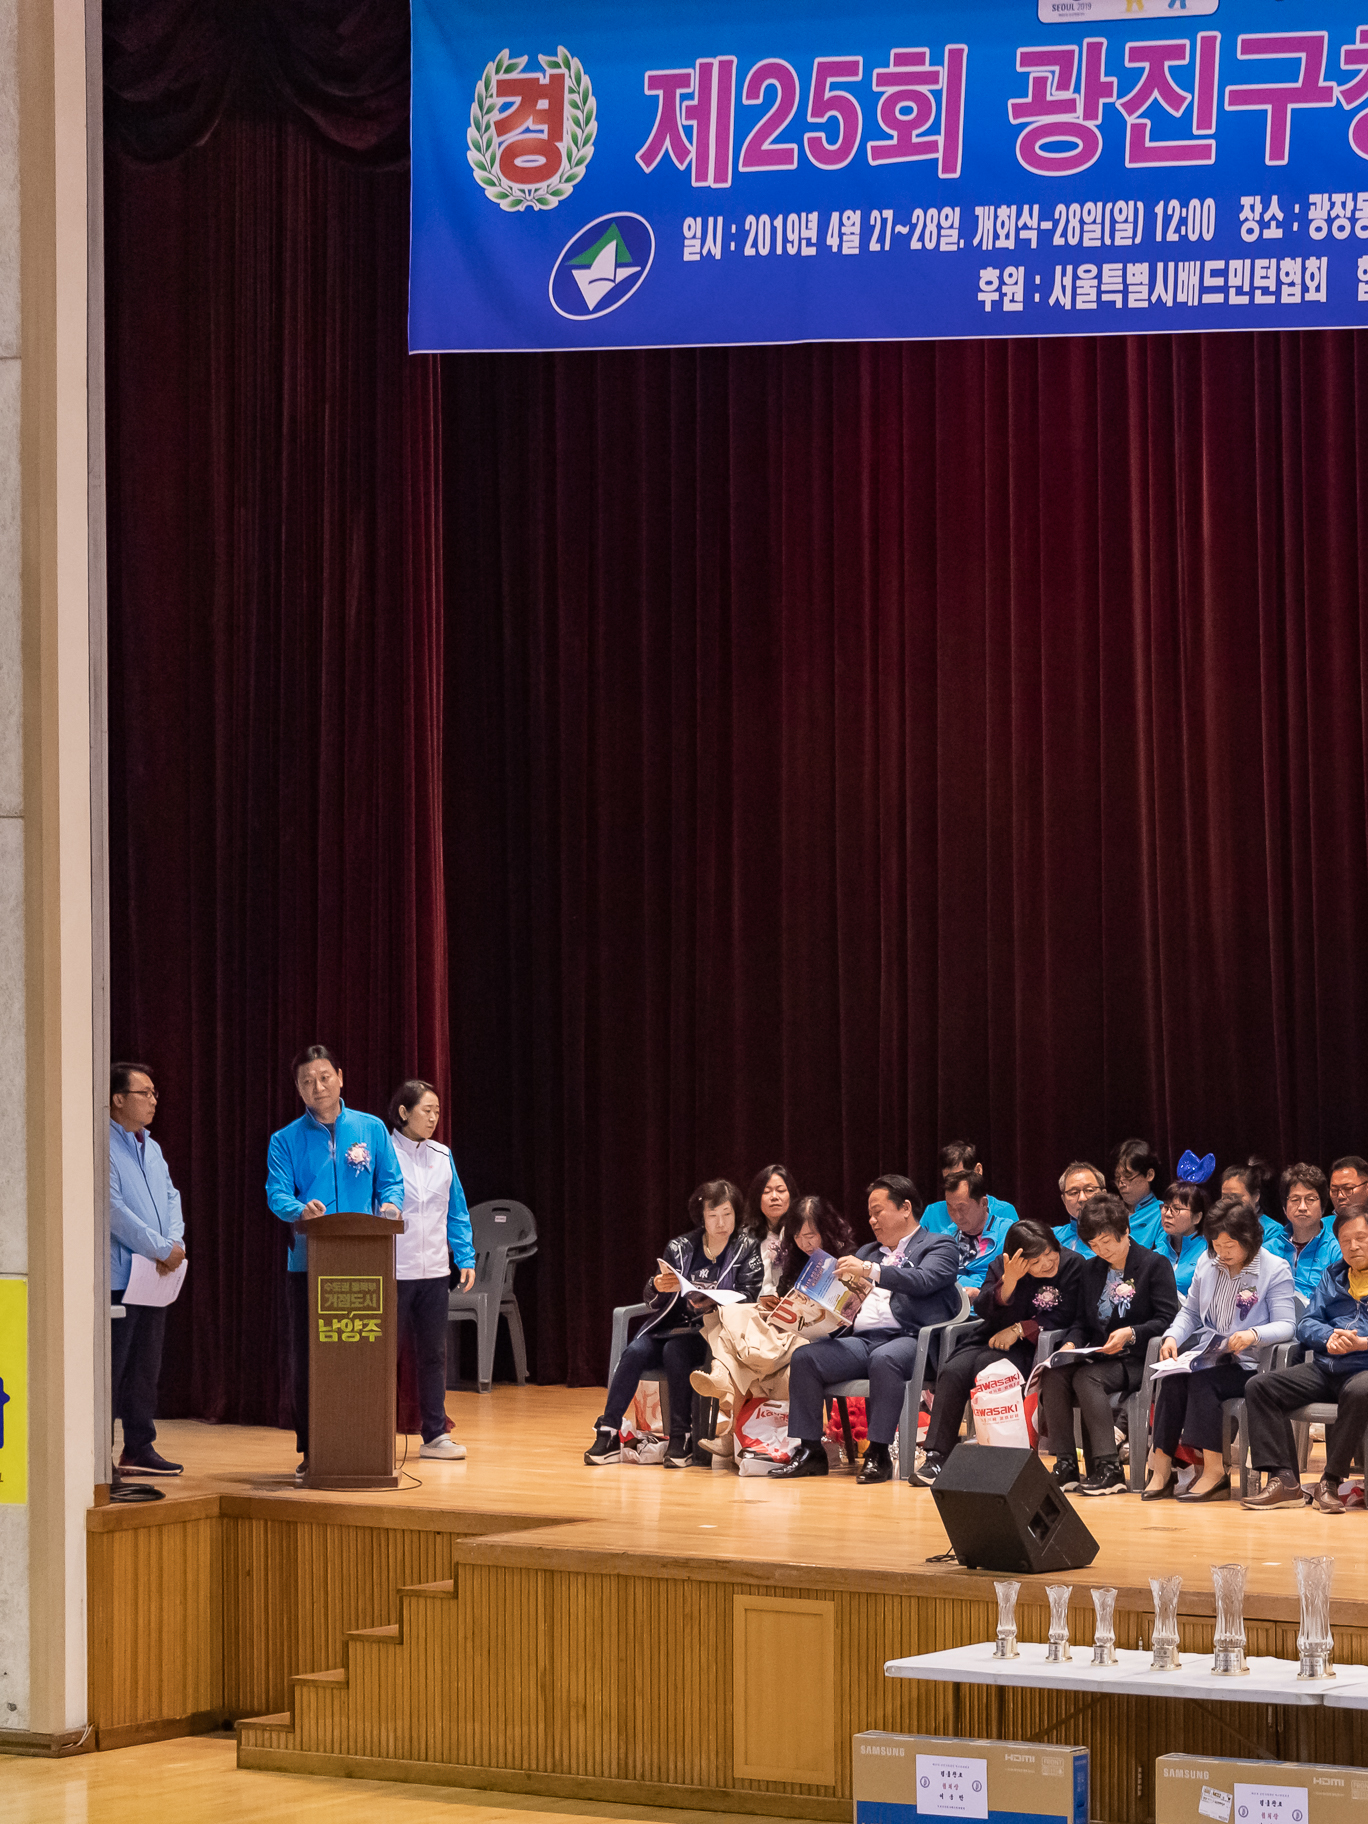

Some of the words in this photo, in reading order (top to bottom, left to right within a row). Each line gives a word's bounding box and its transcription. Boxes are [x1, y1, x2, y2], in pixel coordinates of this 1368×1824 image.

[1051, 3, 1076, 12] SEOUL
[1077, 2, 1092, 11] 2019
[635, 44, 968, 188] 제25회
[493, 69, 567, 186] 경
[683, 216, 724, 262] 일시
[744, 211, 818, 257] 2019년
[826, 209, 861, 255] 4월
[972, 200, 1145, 250] 개회식-28일(일)
[1154, 198, 1216, 242] 12:00
[1239, 195, 1284, 243] 장소
[977, 265, 1025, 312] 후원
[1048, 256, 1328, 310] 서울특별시배드민턴협회
[318, 1318, 382, 1342] 남양주
[860, 1745, 905, 1757] SAMSUNG
[1004, 1753, 1036, 1763] HDMI
[1163, 1768, 1209, 1780] SAMSUNG
[1313, 1776, 1345, 1787] HDMI
